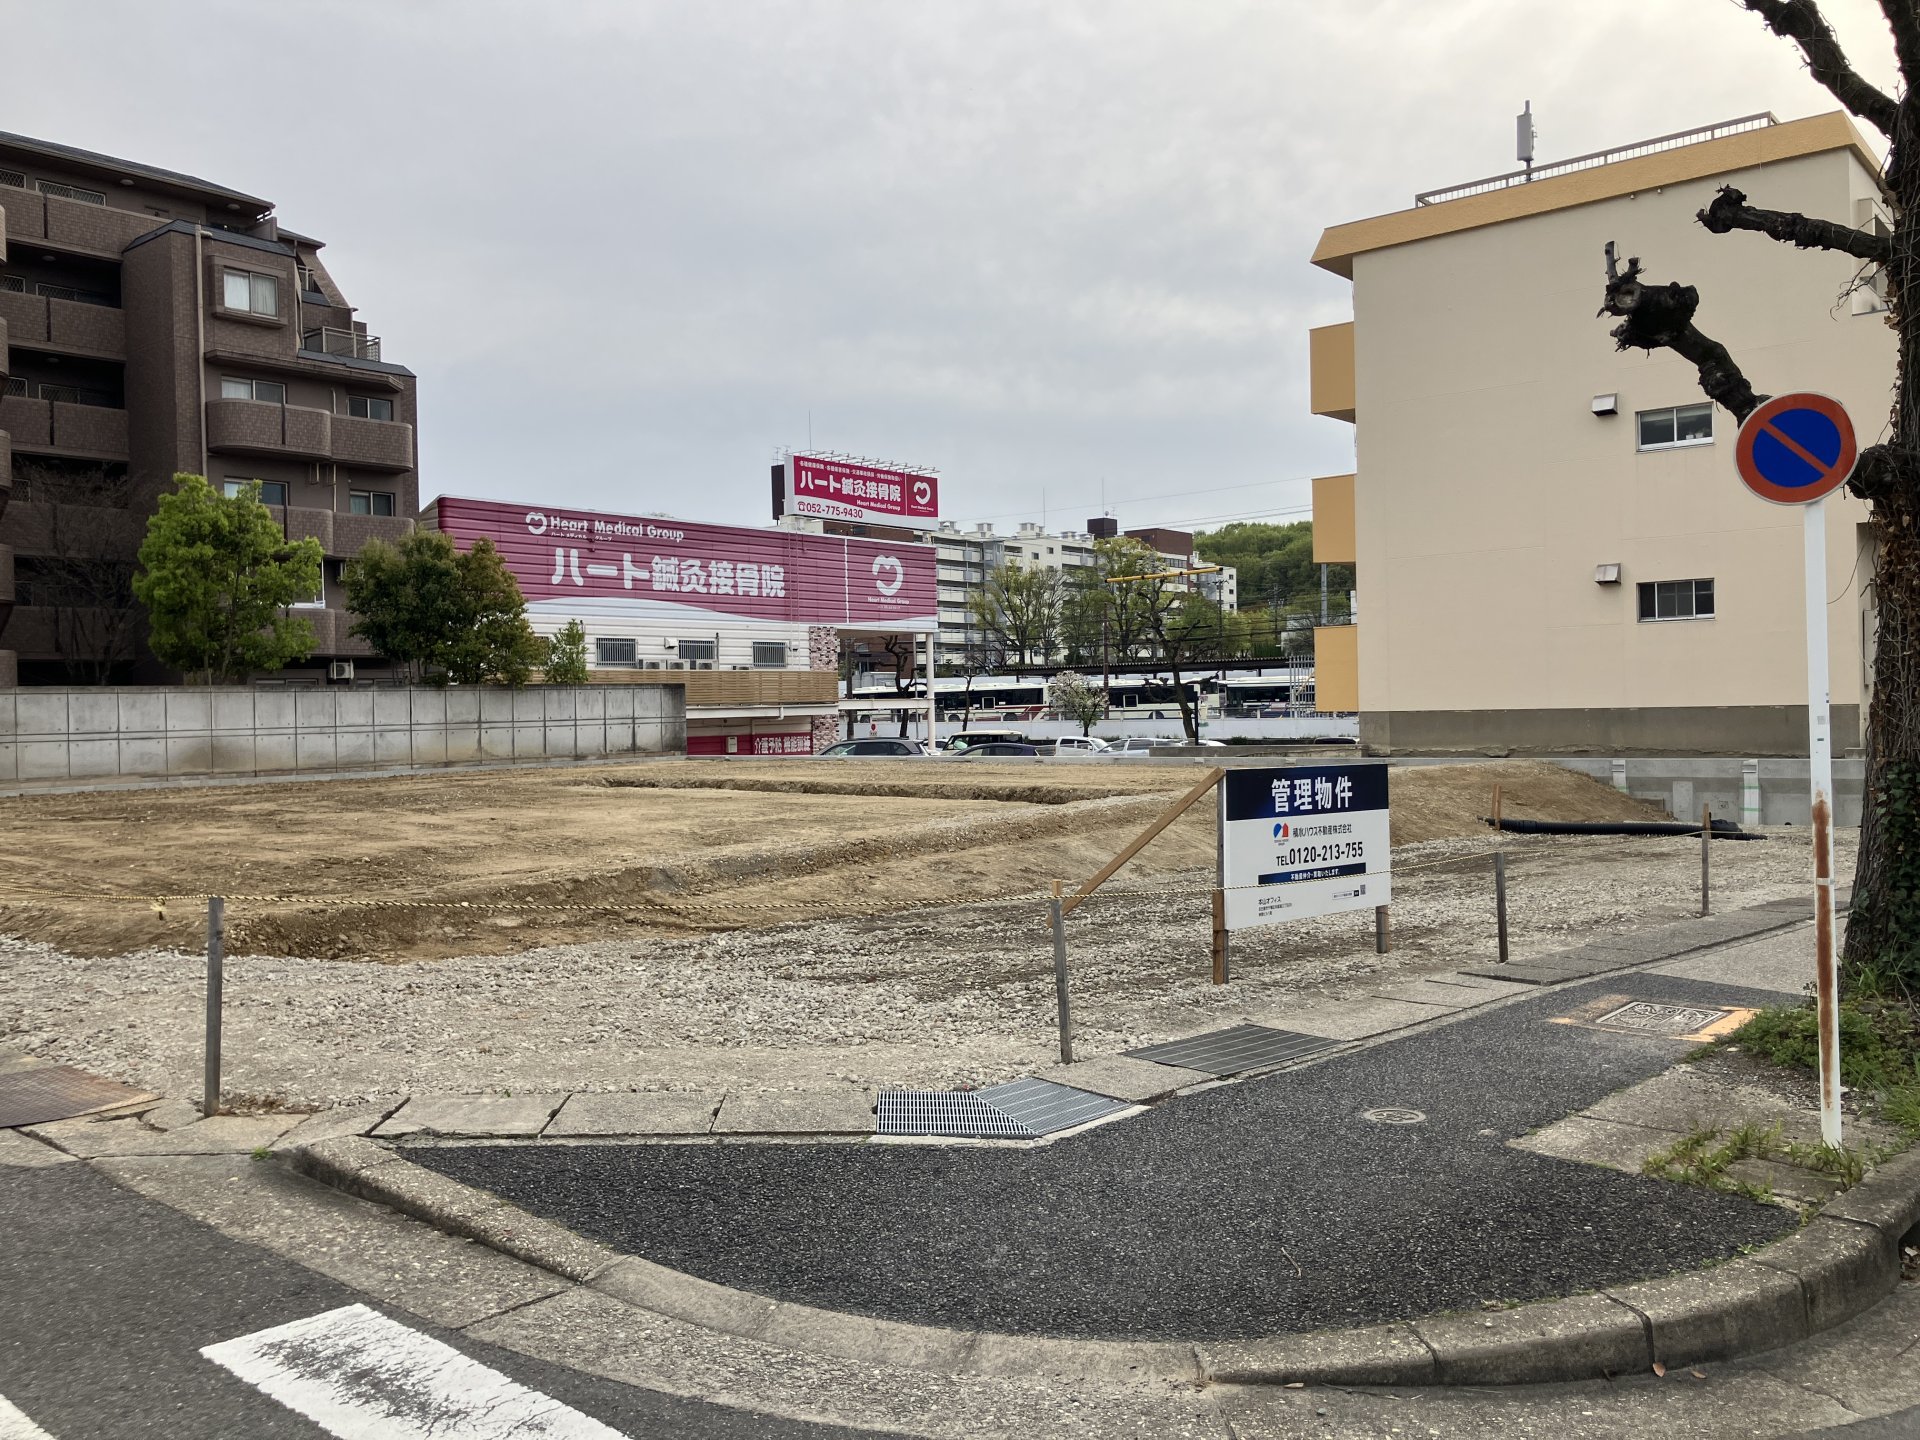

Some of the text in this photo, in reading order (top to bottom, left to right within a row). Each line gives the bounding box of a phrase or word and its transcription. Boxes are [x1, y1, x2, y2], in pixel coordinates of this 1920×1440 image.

[800, 471, 901, 502] ハート鍼灸接骨院
[806, 503, 863, 518] 052-775-9430
[856, 499, 870, 507] Heart
[870, 501, 887, 509] Medical
[887, 503, 901, 512] Group
[550, 515, 684, 543] Heart Medical Group
[551, 547, 786, 598] ハート鍼灸接骨院
[1272, 776, 1352, 813] 管理物件
[1293, 824, 1352, 838] 積水ハウス不動産株式会社
